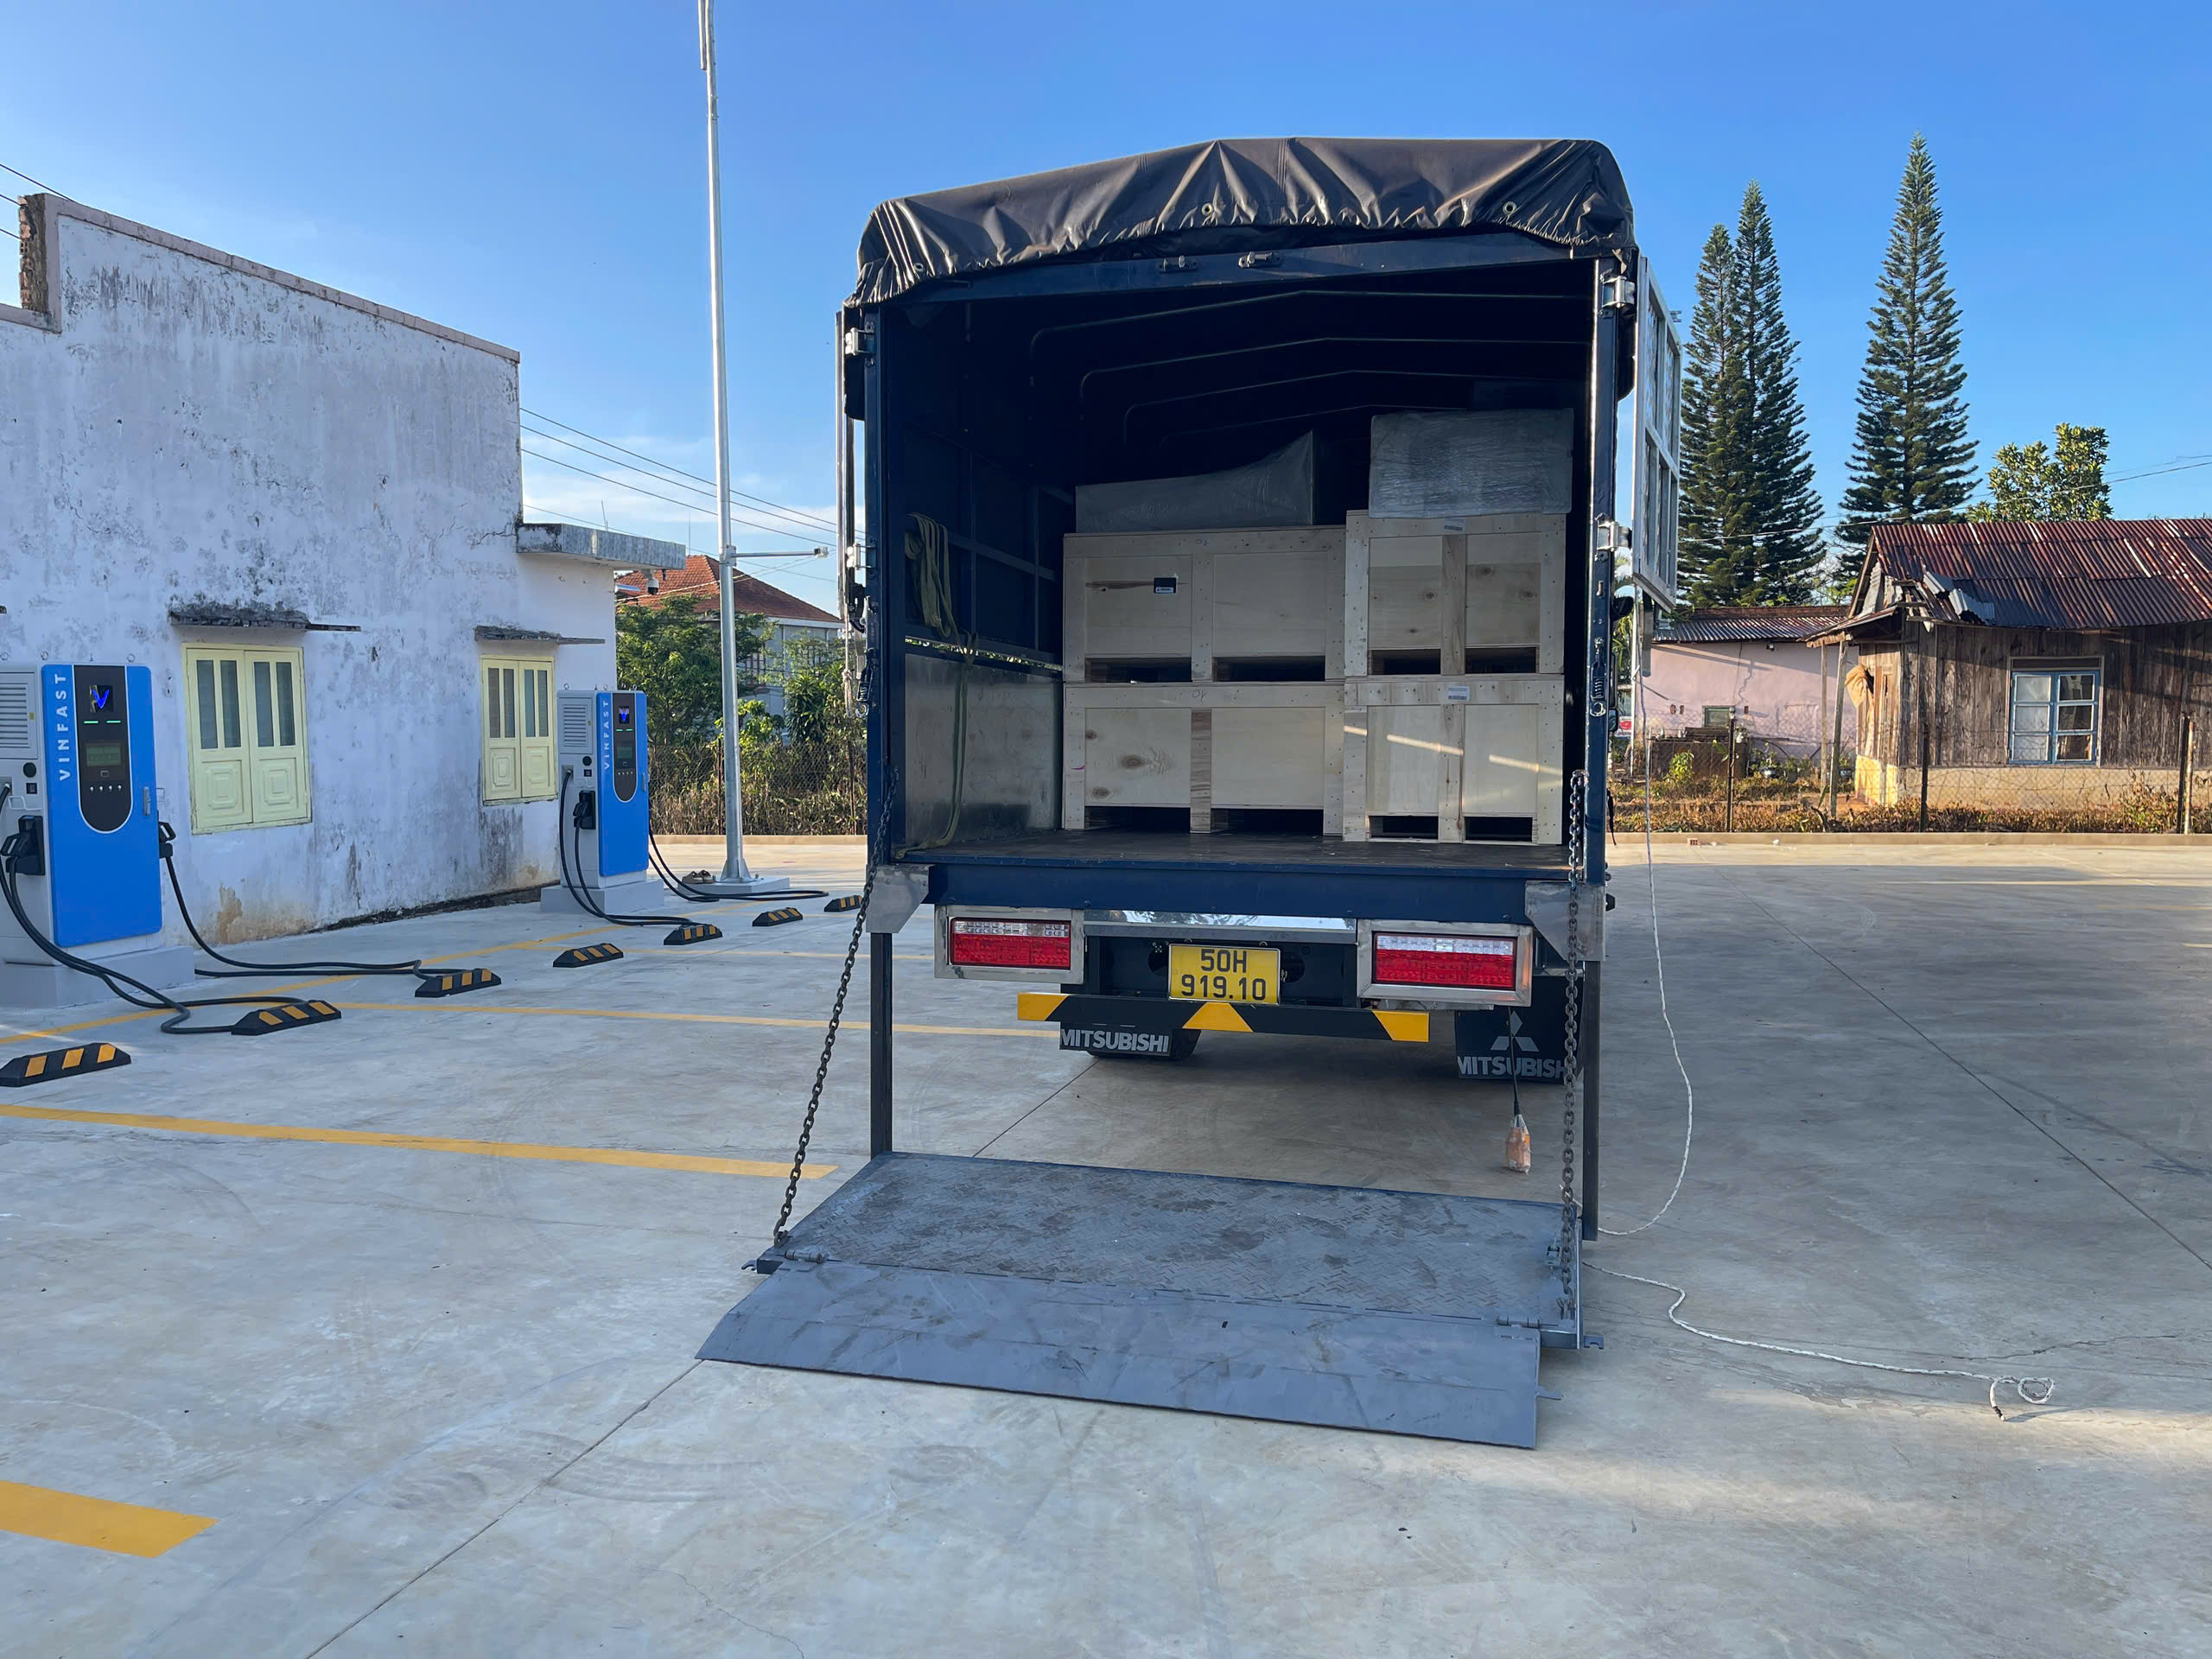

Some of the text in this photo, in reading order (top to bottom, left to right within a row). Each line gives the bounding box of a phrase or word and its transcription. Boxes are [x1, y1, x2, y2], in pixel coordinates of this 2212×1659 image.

[54, 674, 71, 781] VINFAST
[1200, 949, 1248, 974] 50H
[1180, 974, 1267, 1001] 919.10
[1060, 1028, 1169, 1052] MITSUBISHI
[1457, 1055, 1567, 1079] MITSUBISH
